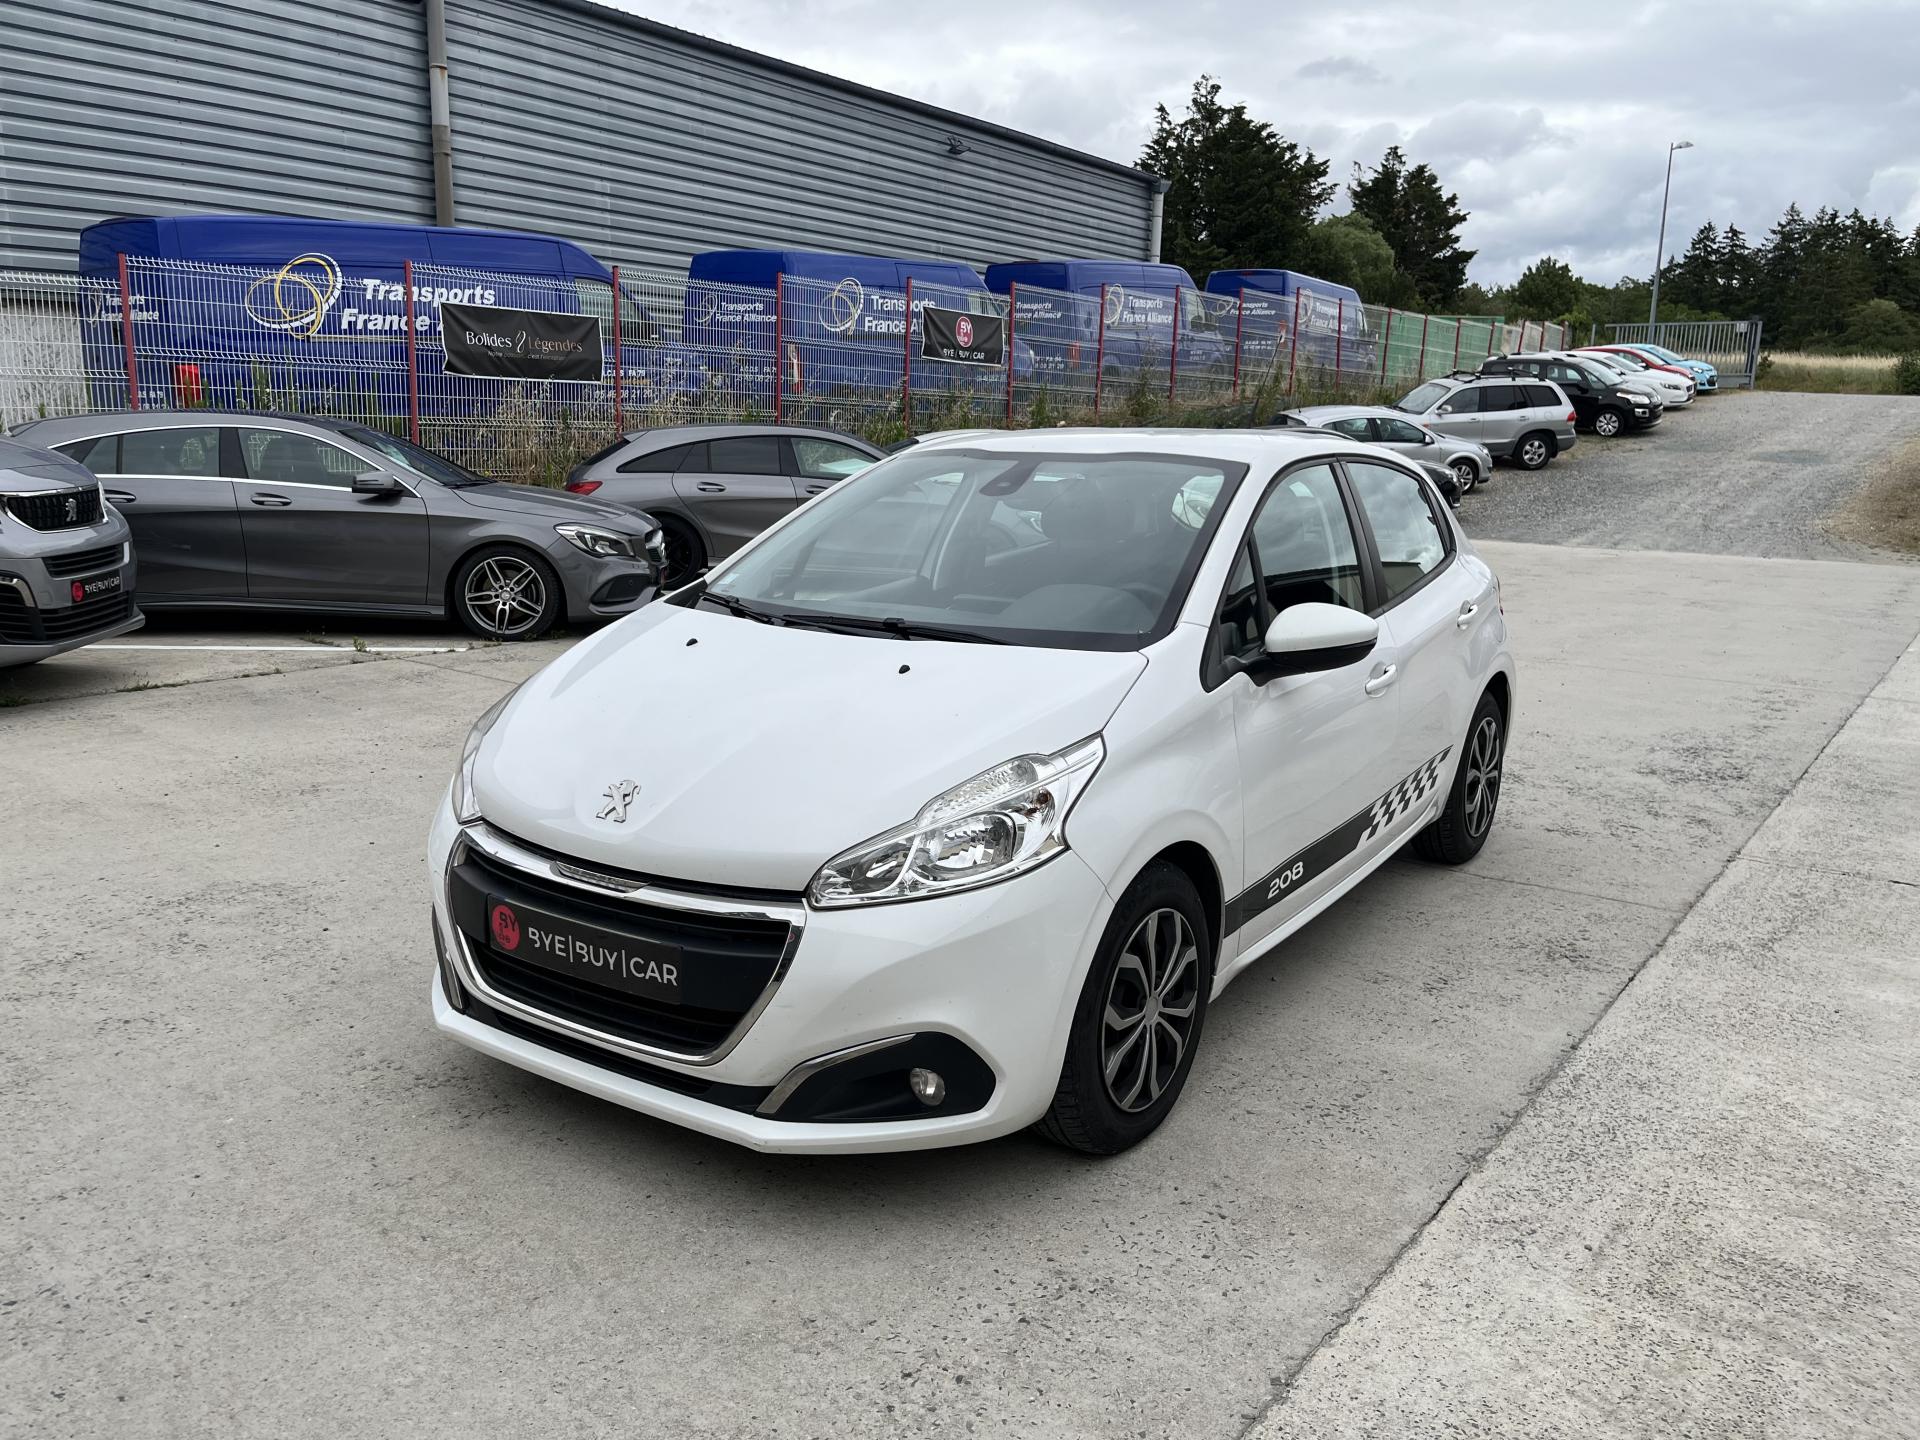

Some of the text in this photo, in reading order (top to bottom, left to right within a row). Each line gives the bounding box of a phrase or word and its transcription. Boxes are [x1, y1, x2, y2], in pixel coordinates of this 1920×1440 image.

[362, 278, 495, 308] Transports
[721, 302, 764, 312] Transports
[1128, 296, 1163, 309] Transports
[341, 308, 431, 331] France
[716, 313, 777, 322] France Alliance
[864, 316, 906, 333] France
[1122, 311, 1146, 323] France
[466, 331, 583, 353] Bolides Légendes
[973, 352, 985, 360] CAR
[1267, 861, 1304, 900] 208
[629, 956, 678, 987] CAR
